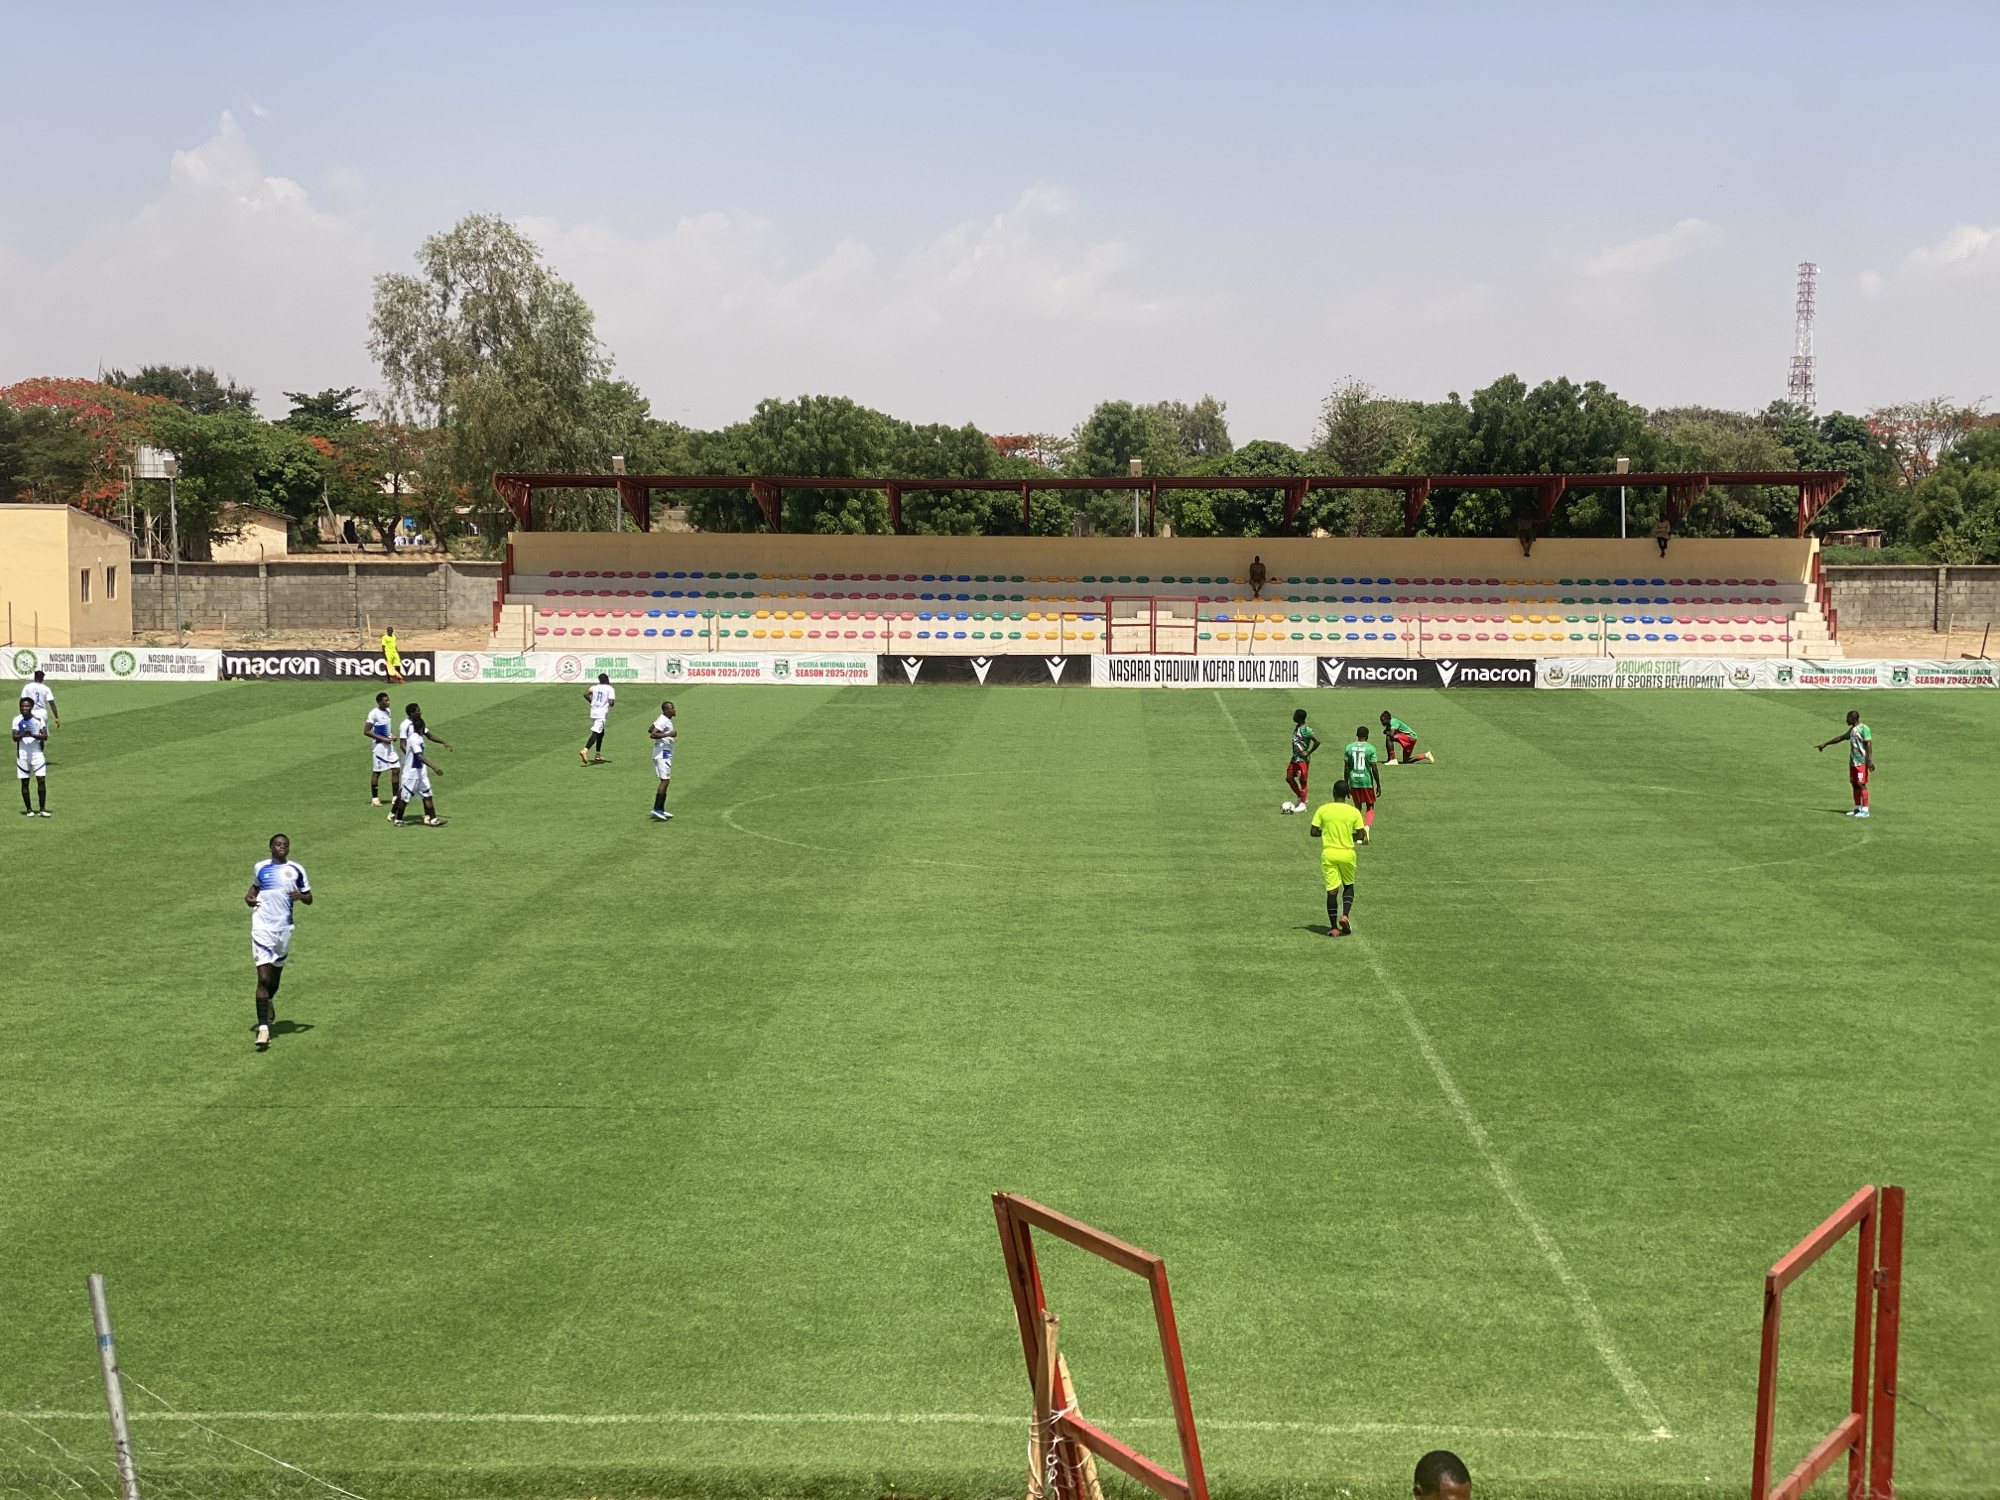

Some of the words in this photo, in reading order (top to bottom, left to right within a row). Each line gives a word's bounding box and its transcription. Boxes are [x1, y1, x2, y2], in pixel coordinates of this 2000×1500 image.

[49, 653, 74, 663] NASARA
[76, 654, 97, 664] UNITED
[148, 654, 174, 663] NASARA
[71, 663, 86, 672] CLUB
[87, 664, 105, 673] ZARIA
[139, 663, 168, 673] FOOTBALL
[169, 664, 186, 673] CLUB
[226, 657, 320, 675] macron
[335, 658, 430, 676] macon
[1109, 659, 1151, 681] NASARA
[1154, 660, 1199, 682] STADIUM
[1203, 660, 1235, 682] KOFAR
[1238, 660, 1266, 682] DOKA
[1268, 660, 1299, 682] ZARIA
[1615, 660, 1652, 674] KADUNA
[1654, 661, 1681, 674] STATE
[687, 668, 716, 676] SEASON
[717, 668, 760, 677] 2025/2026
[795, 669, 824, 677] SEASON
[825, 669, 868, 678] 2025/2026
[1347, 667, 1418, 681] macron
[1460, 668, 1531, 682] macron
[1570, 674, 1614, 688] MINISTRY
[1615, 675, 1626, 688] OF
[1627, 675, 1663, 688] SPORTS
[1665, 675, 1725, 688] DEVELOPMENT
[1800, 676, 1830, 684] SEASON
[1832, 676, 1878, 684] 2025/2026
[1914, 676, 1945, 684] SEASON
[1946, 676, 1993, 684] 2025/2026
[1352, 751, 1366, 770] 10
